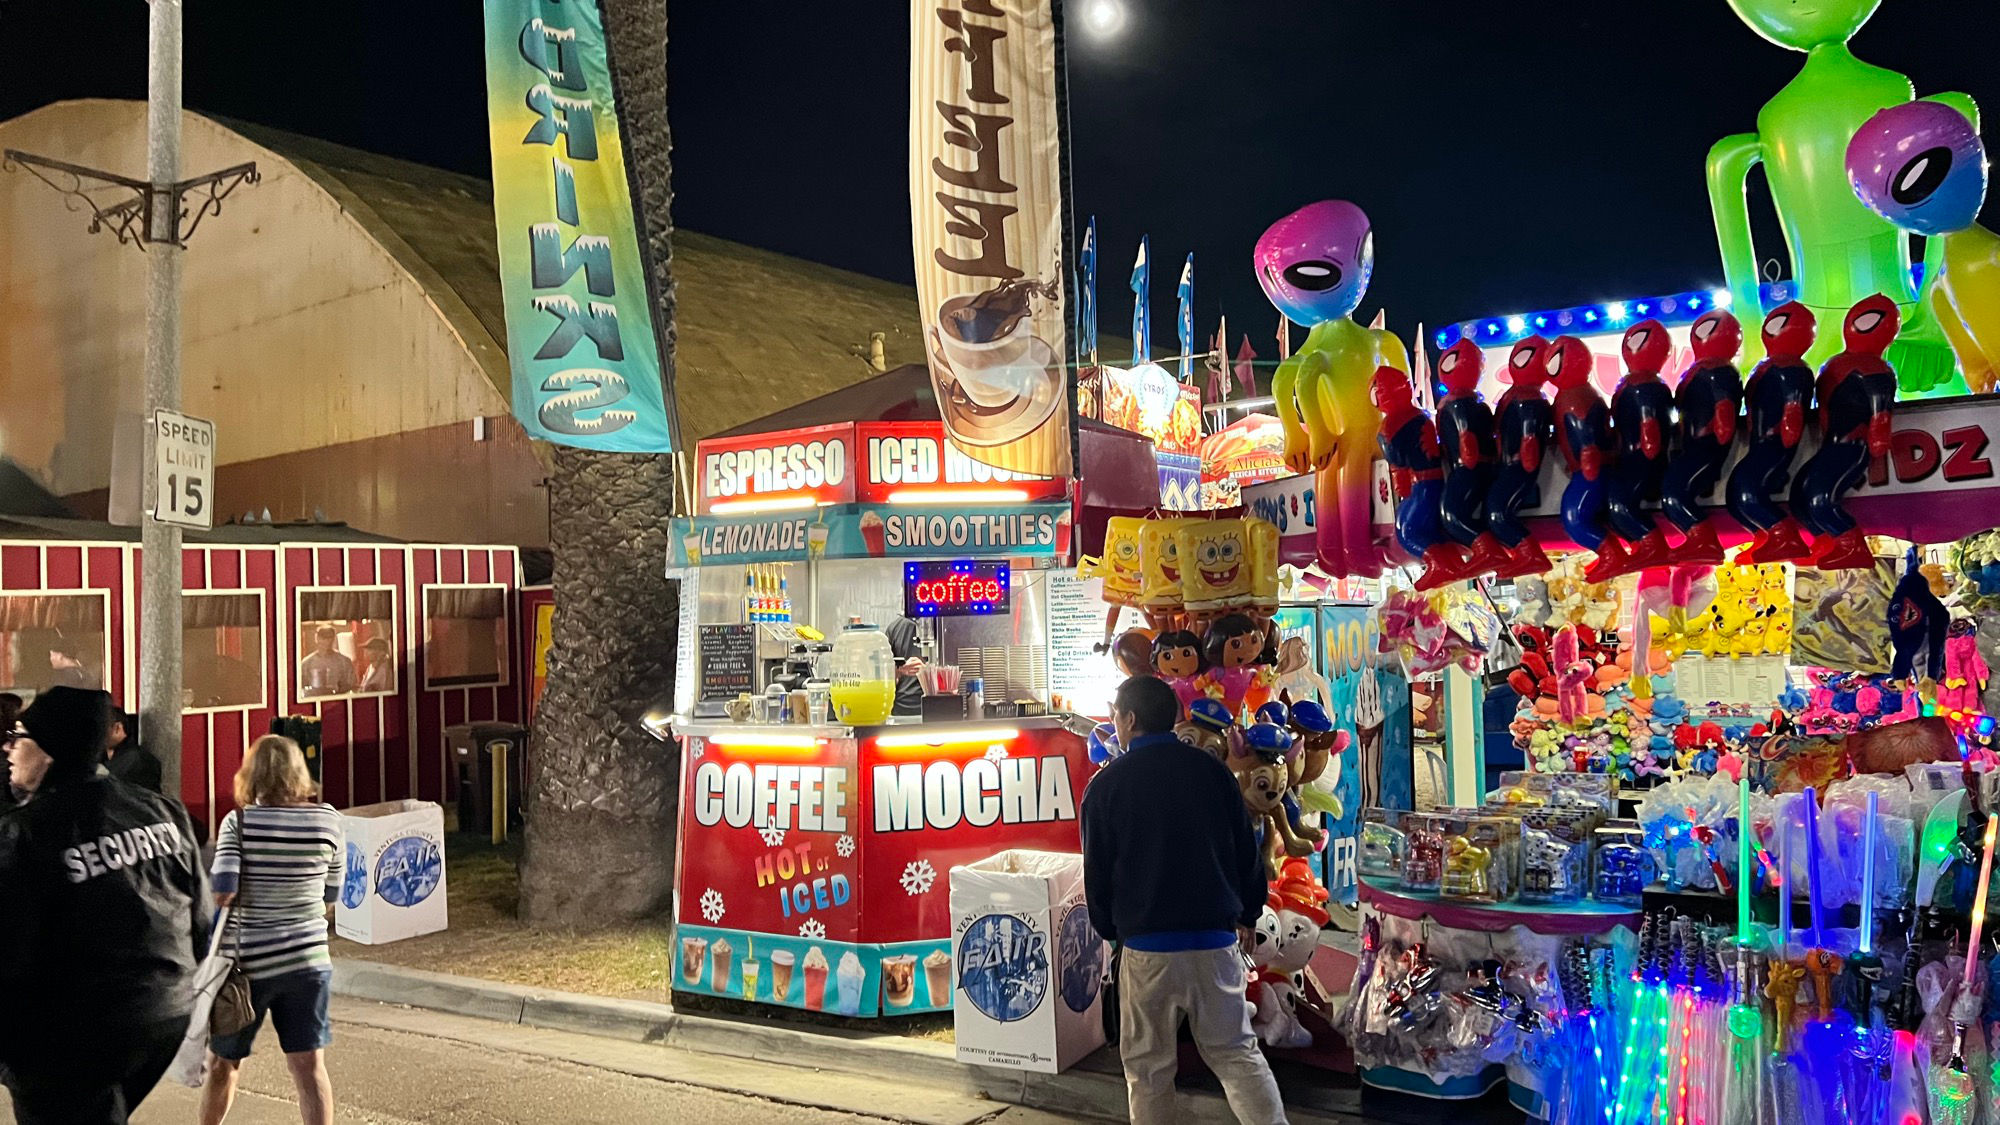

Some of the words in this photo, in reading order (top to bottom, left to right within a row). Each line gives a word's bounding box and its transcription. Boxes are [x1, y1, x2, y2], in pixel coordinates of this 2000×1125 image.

[161, 419, 210, 446] SPEED
[165, 446, 206, 471] LIMIT
[706, 438, 845, 498] ESPRESSO
[869, 437, 941, 484] ICED
[1229, 469, 1257, 479] MEXICAN
[167, 473, 203, 517] 15
[701, 519, 807, 556] LEMONADE
[886, 513, 1055, 549] SMOOTHIES
[915, 574, 1000, 603] coffee
[695, 762, 847, 833] COFFEE
[873, 755, 1076, 832] MOCHA
[64, 820, 183, 884] SECURITY
[374, 840, 441, 896] FAIR
[754, 841, 812, 888] HOT
[780, 874, 851, 918] ICED
[957, 931, 1049, 989] FAIR
